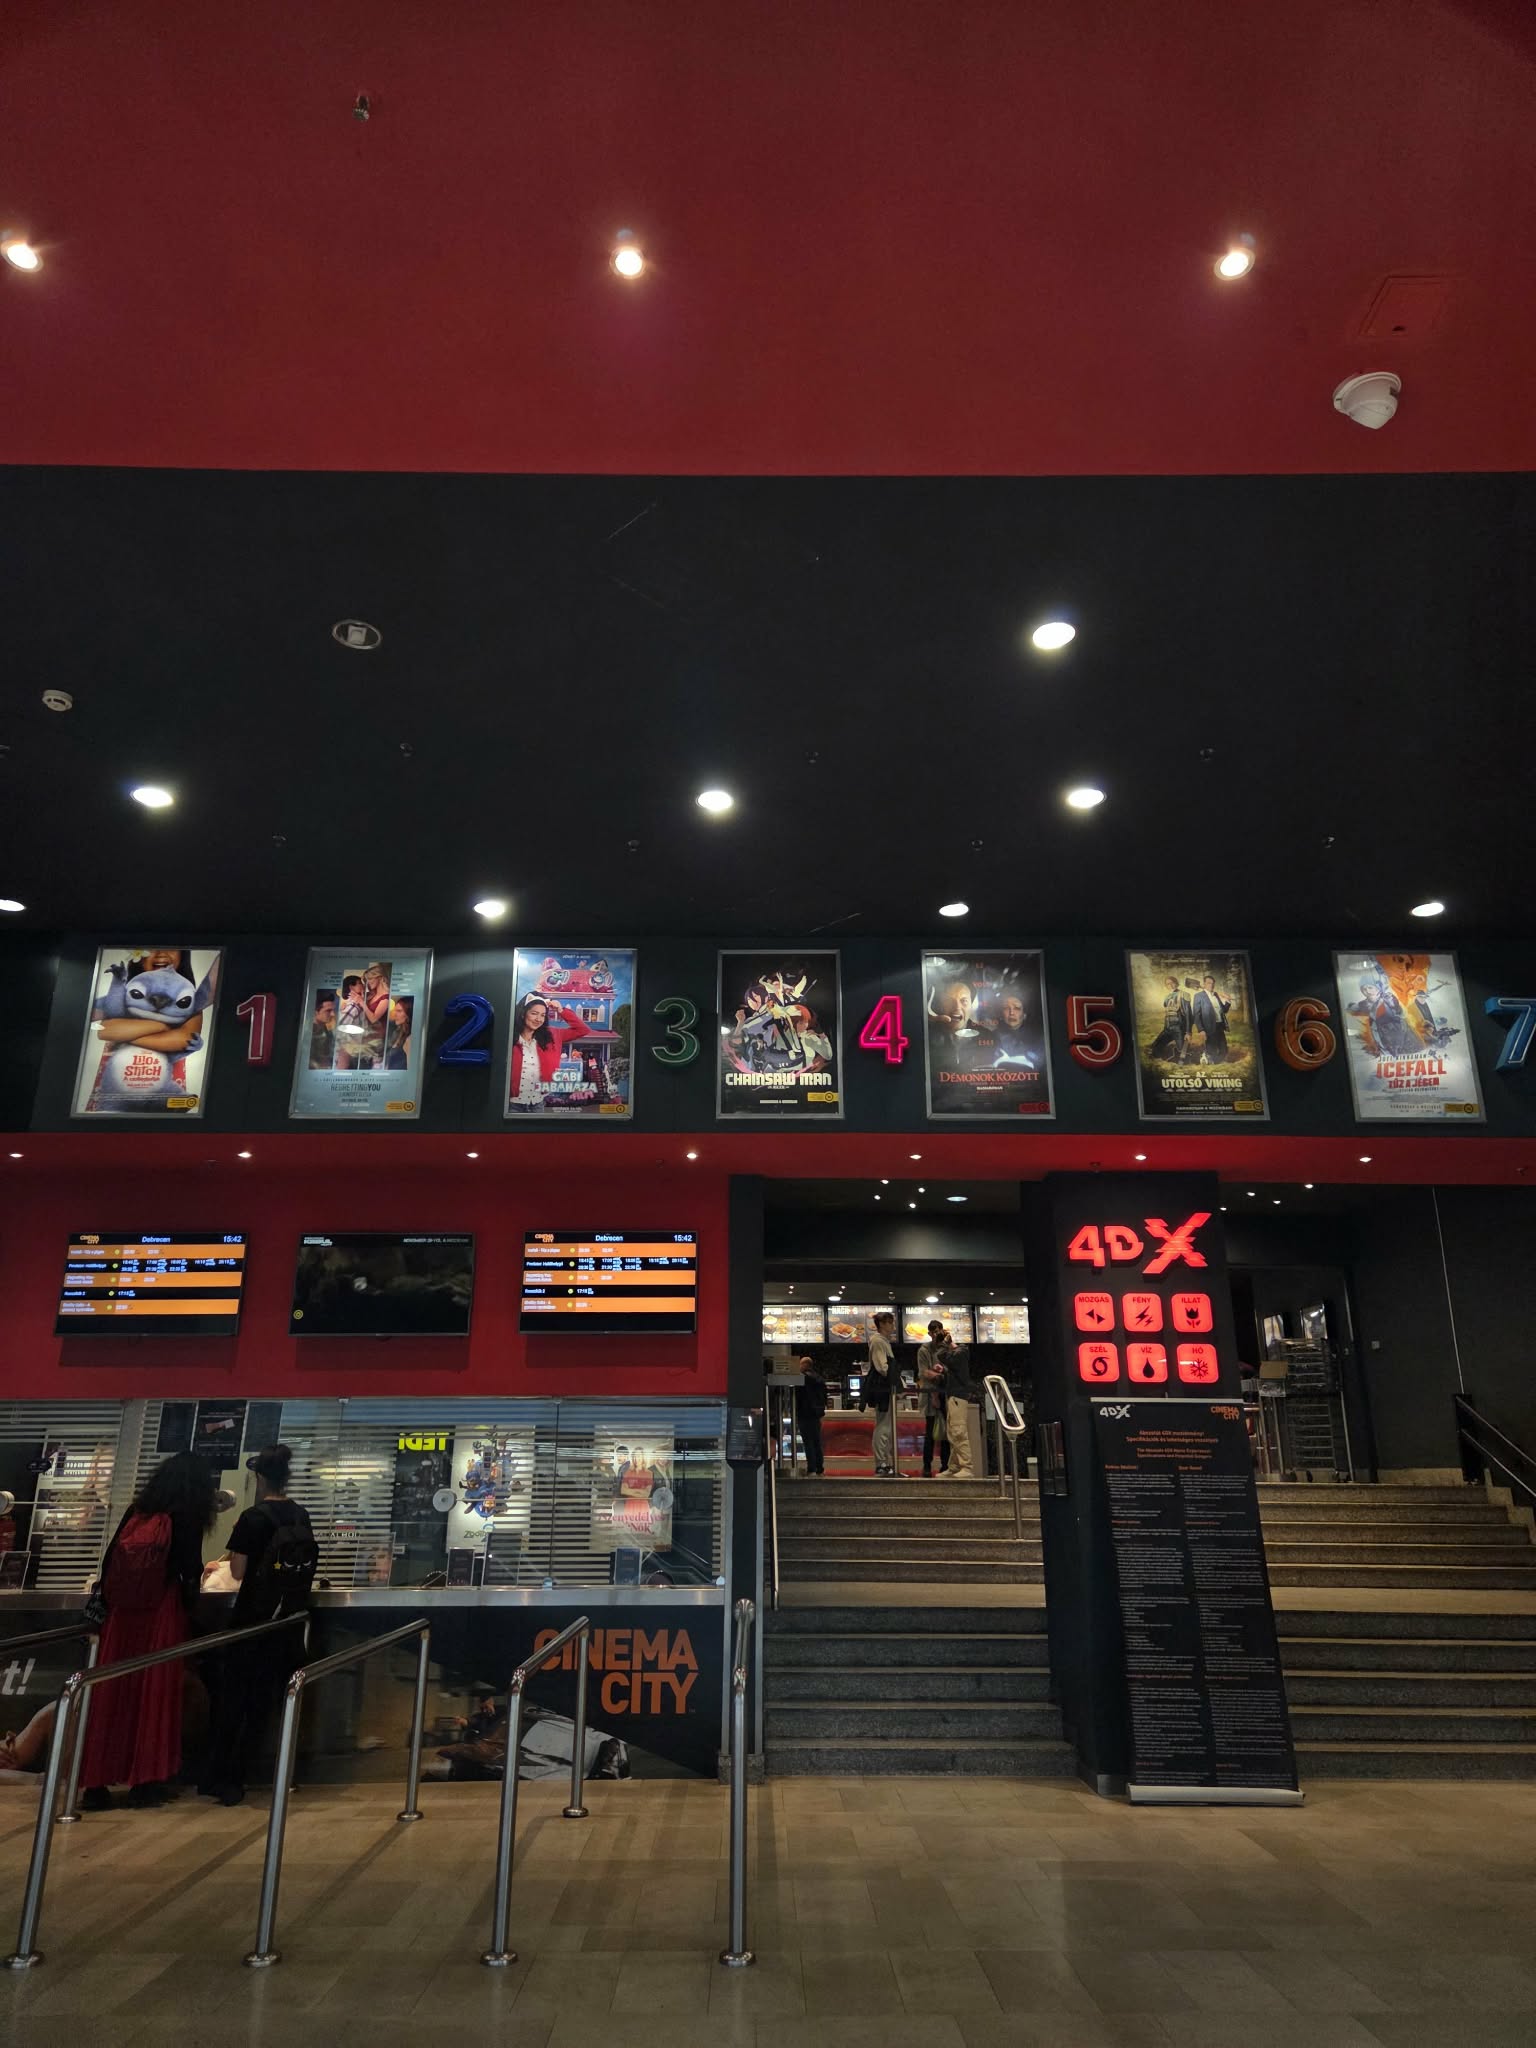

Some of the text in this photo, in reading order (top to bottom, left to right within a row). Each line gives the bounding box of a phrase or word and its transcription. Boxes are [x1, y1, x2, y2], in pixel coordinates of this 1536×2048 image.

[236, 992, 277, 1068] 1
[439, 993, 494, 1067] 2
[651, 996, 701, 1070] 3
[859, 994, 909, 1065] 4
[1066, 995, 1124, 1071] 5
[1275, 996, 1337, 1072] 6
[1484, 995, 1536, 1073] 7
[552, 1071, 583, 1082] GABI
[939, 1071, 995, 1083] DÉMONOK
[1376, 1058, 1447, 1079] ICEFALL
[726, 1073, 832, 1086] CHAINSAW MAN
[1161, 1078, 1243, 1089] UTOLSÓ VIKING
[223, 1235, 242, 1243] 15:42
[1067, 1212, 1211, 1274] 4DX
[1078, 1295, 1110, 1303] MOZGÁS
[1089, 1345, 1108, 1353] SZÉL
[1141, 1346, 1152, 1354] VÍZ
[1192, 1346, 1204, 1354] HÓ
[1099, 1404, 1131, 1420] 4DX
[1223, 1412, 1240, 1420] CITY
[534, 1629, 699, 1670] CINEMA
[601, 1672, 699, 1714] CITY
